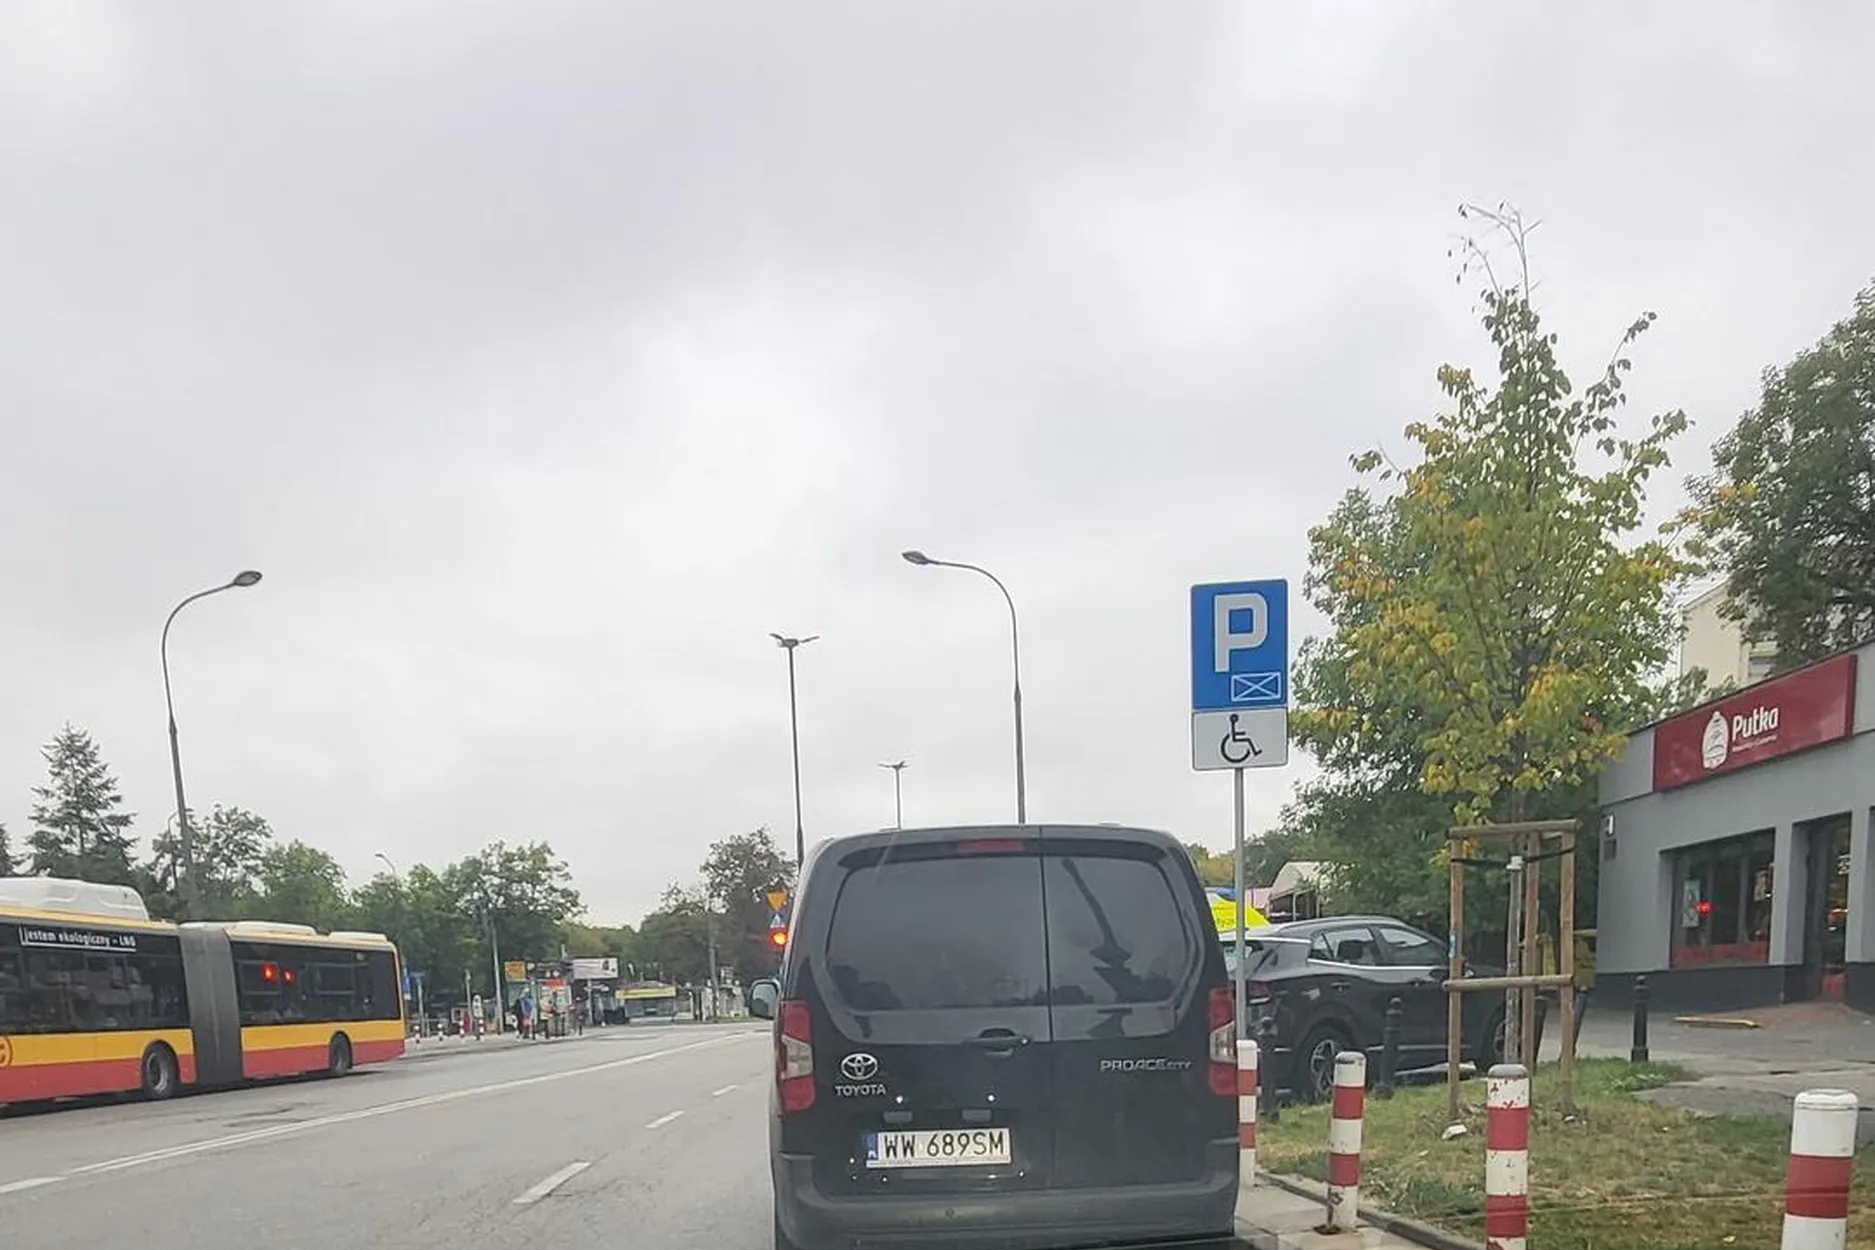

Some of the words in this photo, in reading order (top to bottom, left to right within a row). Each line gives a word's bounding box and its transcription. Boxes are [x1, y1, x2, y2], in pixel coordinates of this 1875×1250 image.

[1215, 593, 1268, 673] P
[1732, 706, 1779, 742] Putka
[24, 927, 56, 942] jestem
[1100, 1058, 1166, 1071] PROACE
[835, 1083, 887, 1096] TOYOTA
[884, 1133, 916, 1159] WW
[926, 1131, 1004, 1157] 689SM
